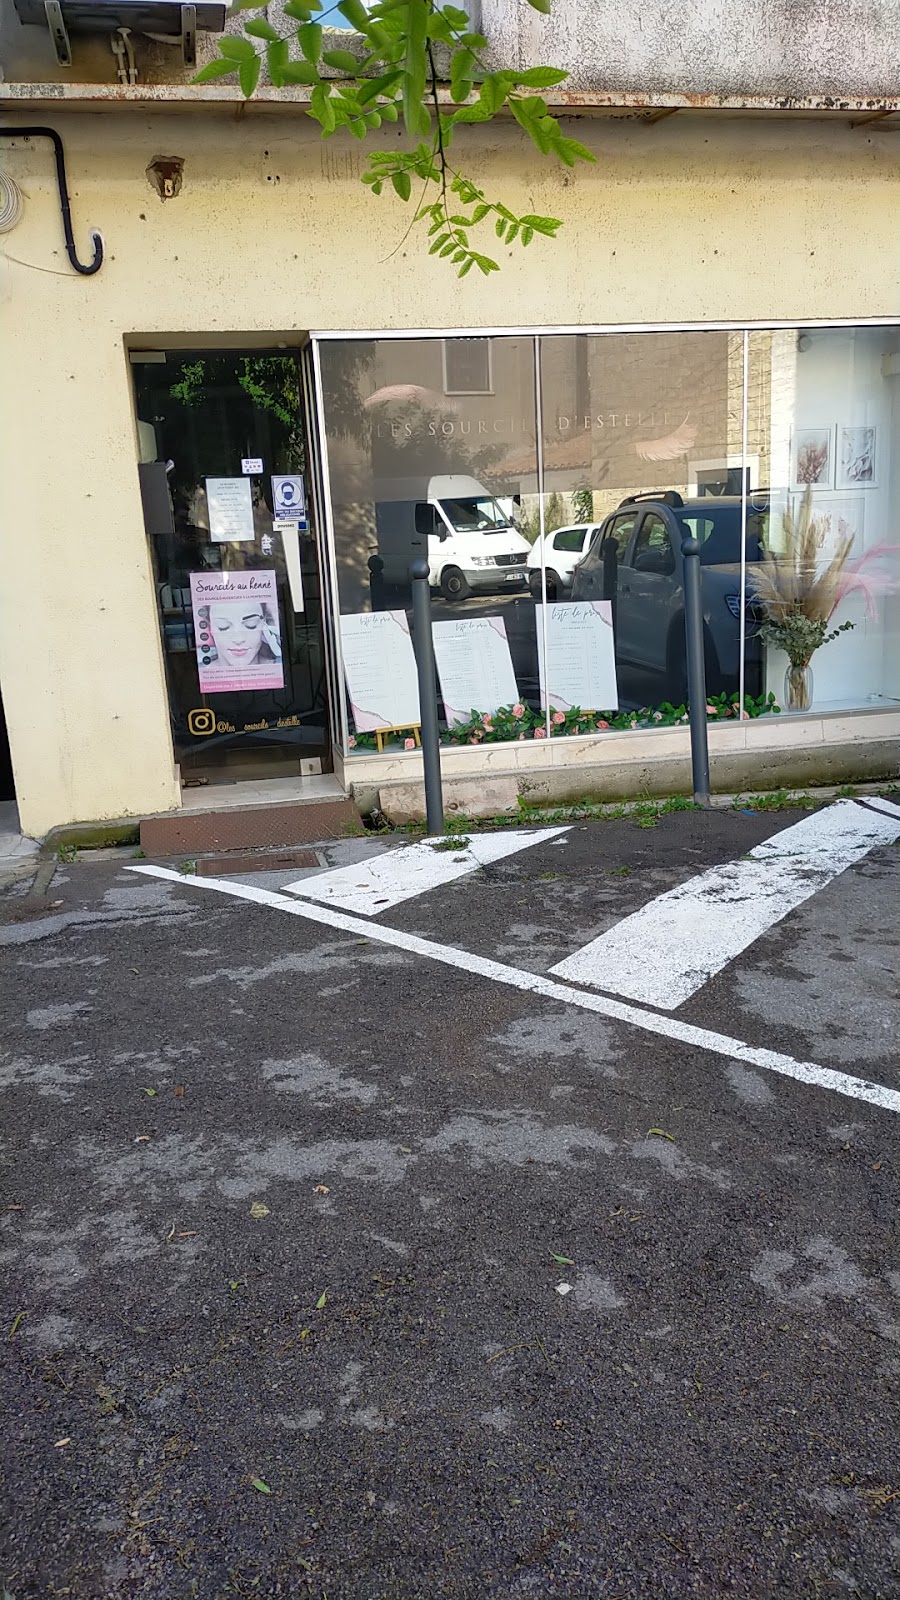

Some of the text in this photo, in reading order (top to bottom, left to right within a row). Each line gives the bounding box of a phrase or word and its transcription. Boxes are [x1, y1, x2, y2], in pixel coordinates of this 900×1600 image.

[377, 411, 671, 438] LES SOURCIL D'ESTELLE
[195, 579, 235, 593] Sourcils
[249, 576, 272, 590] henné
